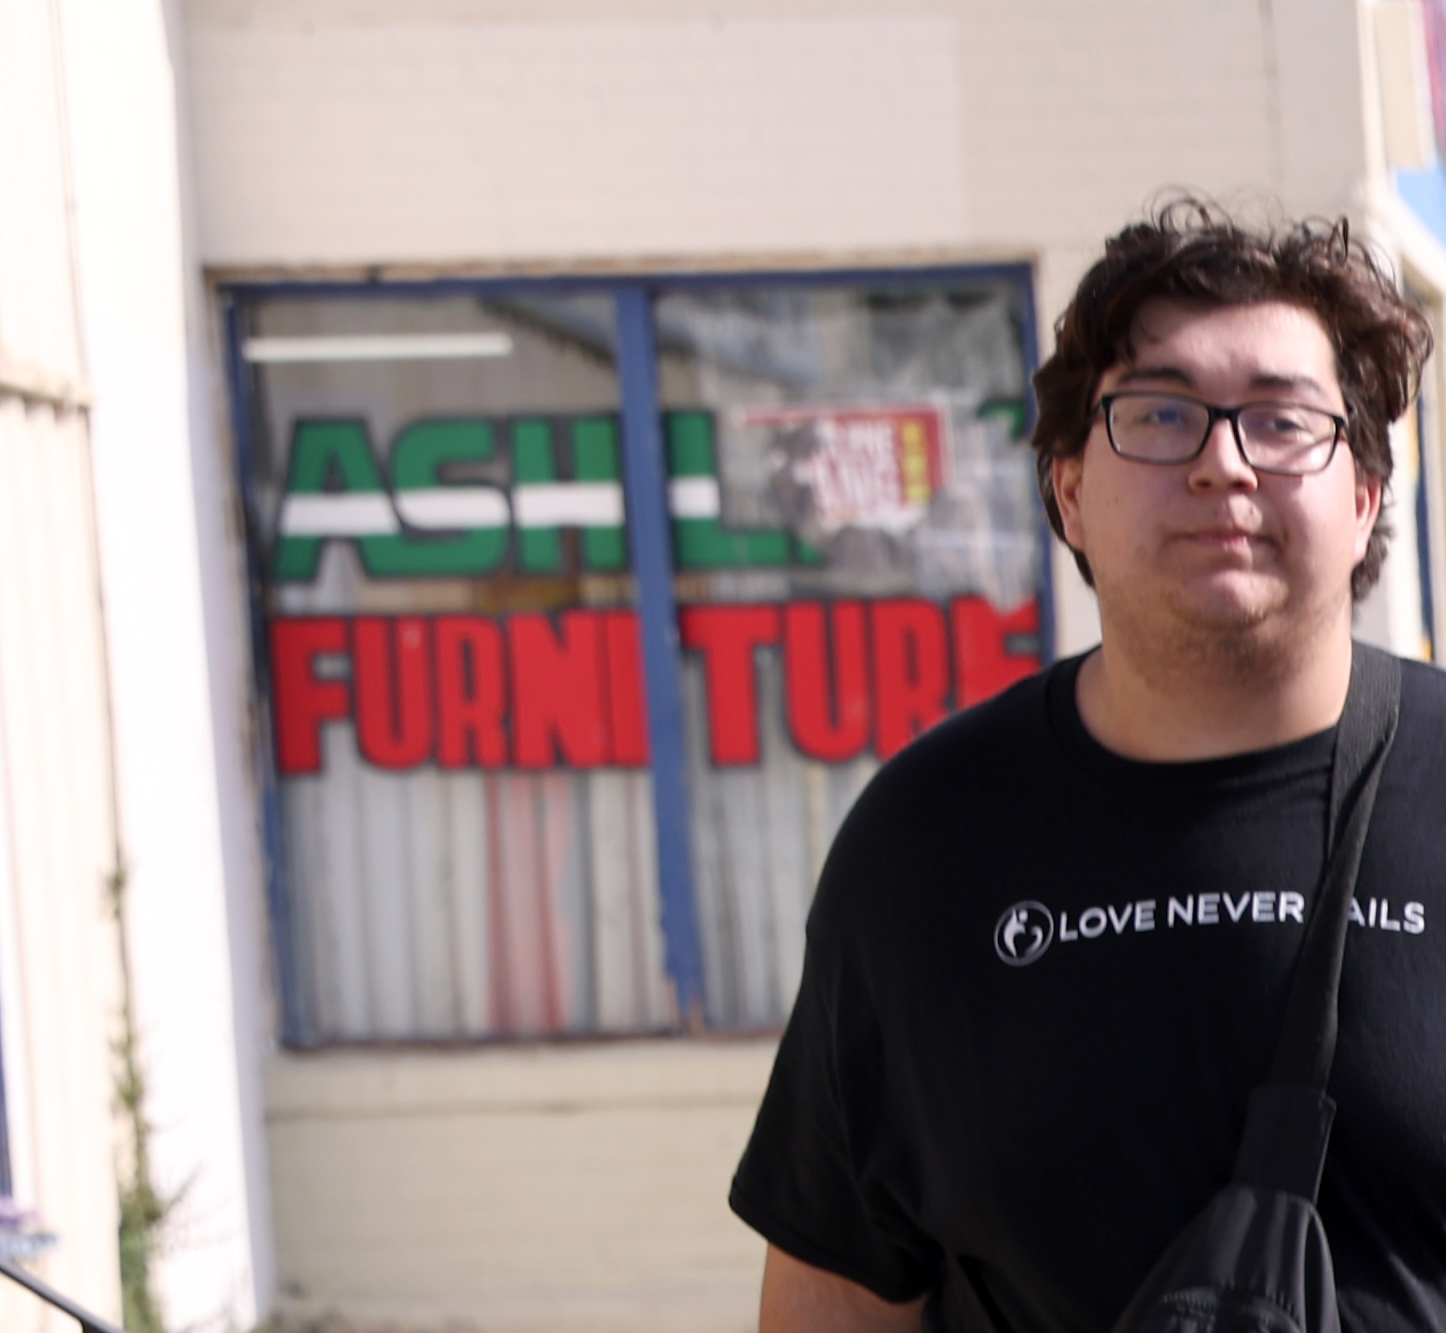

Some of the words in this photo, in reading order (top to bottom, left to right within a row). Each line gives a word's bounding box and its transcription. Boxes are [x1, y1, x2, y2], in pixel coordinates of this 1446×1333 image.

[274, 402, 1028, 581] ASHL
[1058, 900, 1156, 941] LOVE
[1168, 891, 1305, 929] NEVER
[1346, 896, 1426, 935] AILS
